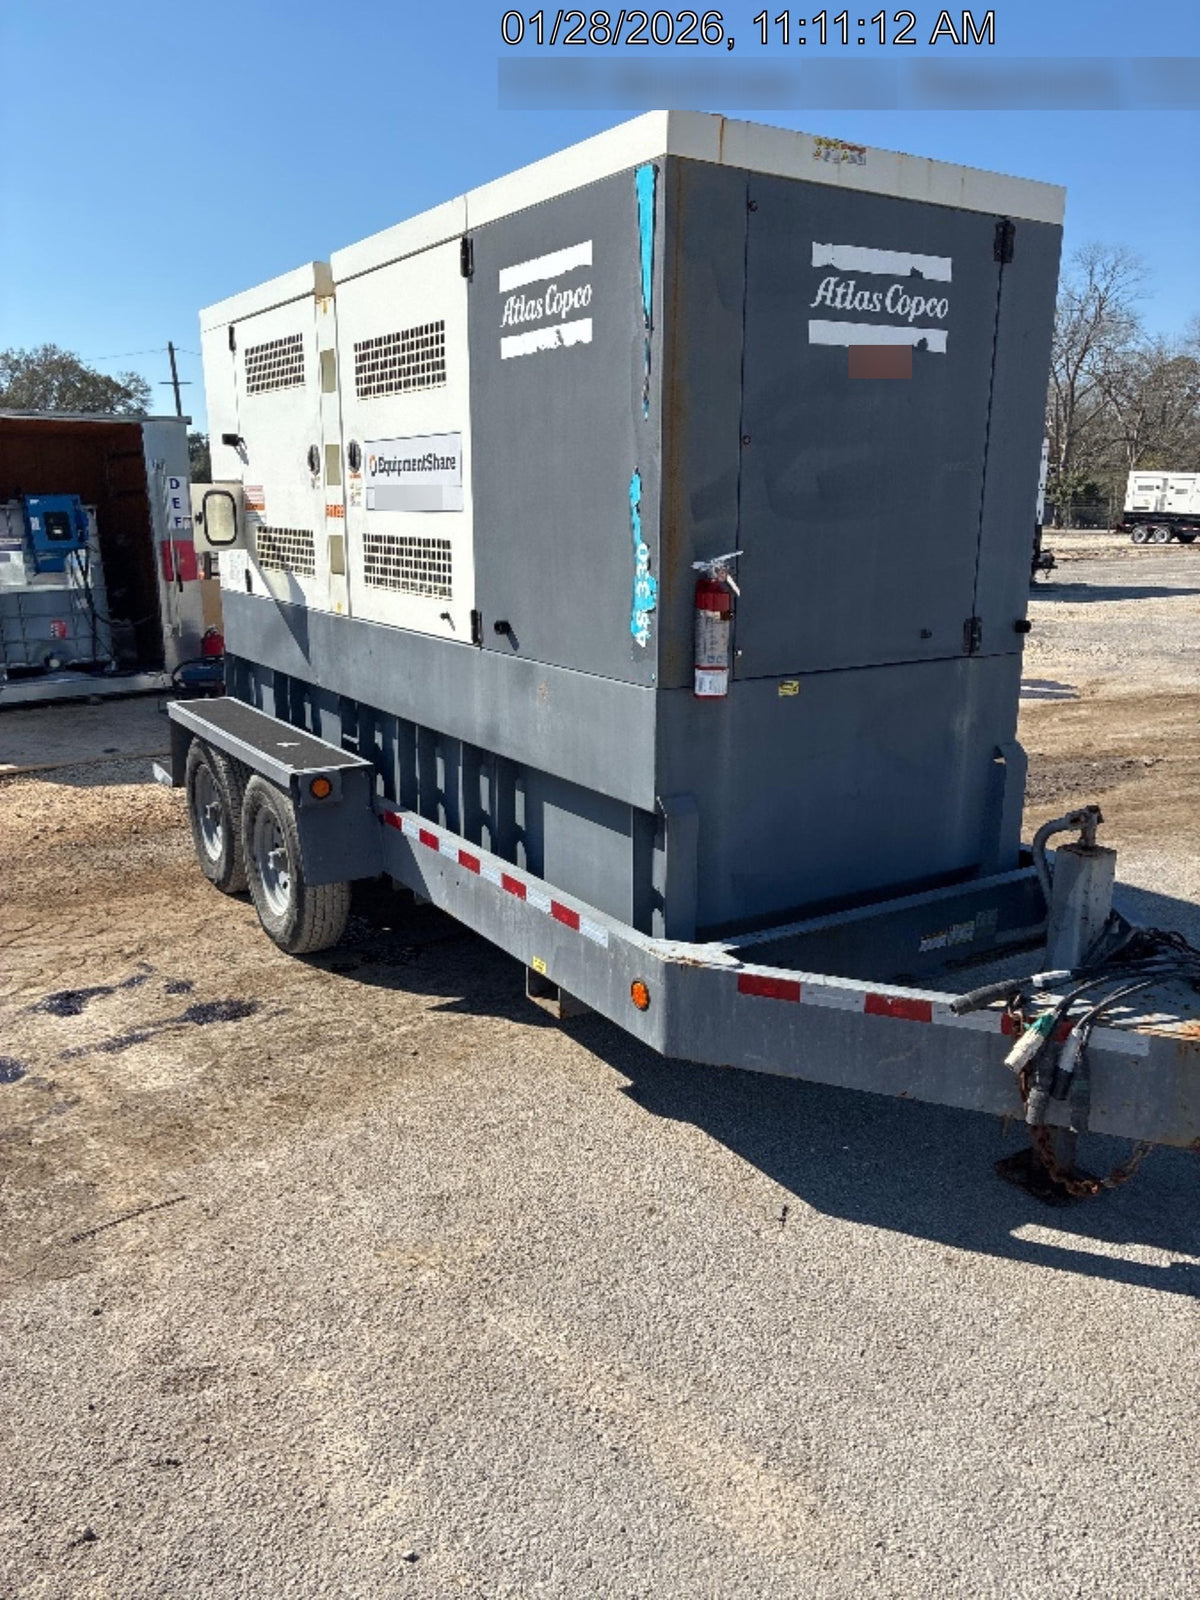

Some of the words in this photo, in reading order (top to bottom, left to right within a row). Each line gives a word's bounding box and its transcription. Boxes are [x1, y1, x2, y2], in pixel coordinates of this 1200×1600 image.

[499, 294, 544, 328] Atlas
[545, 284, 593, 319] Copco
[810, 276, 883, 312] Atlas
[885, 284, 949, 323] Copco
[378, 452, 456, 477] EquipmentShare
